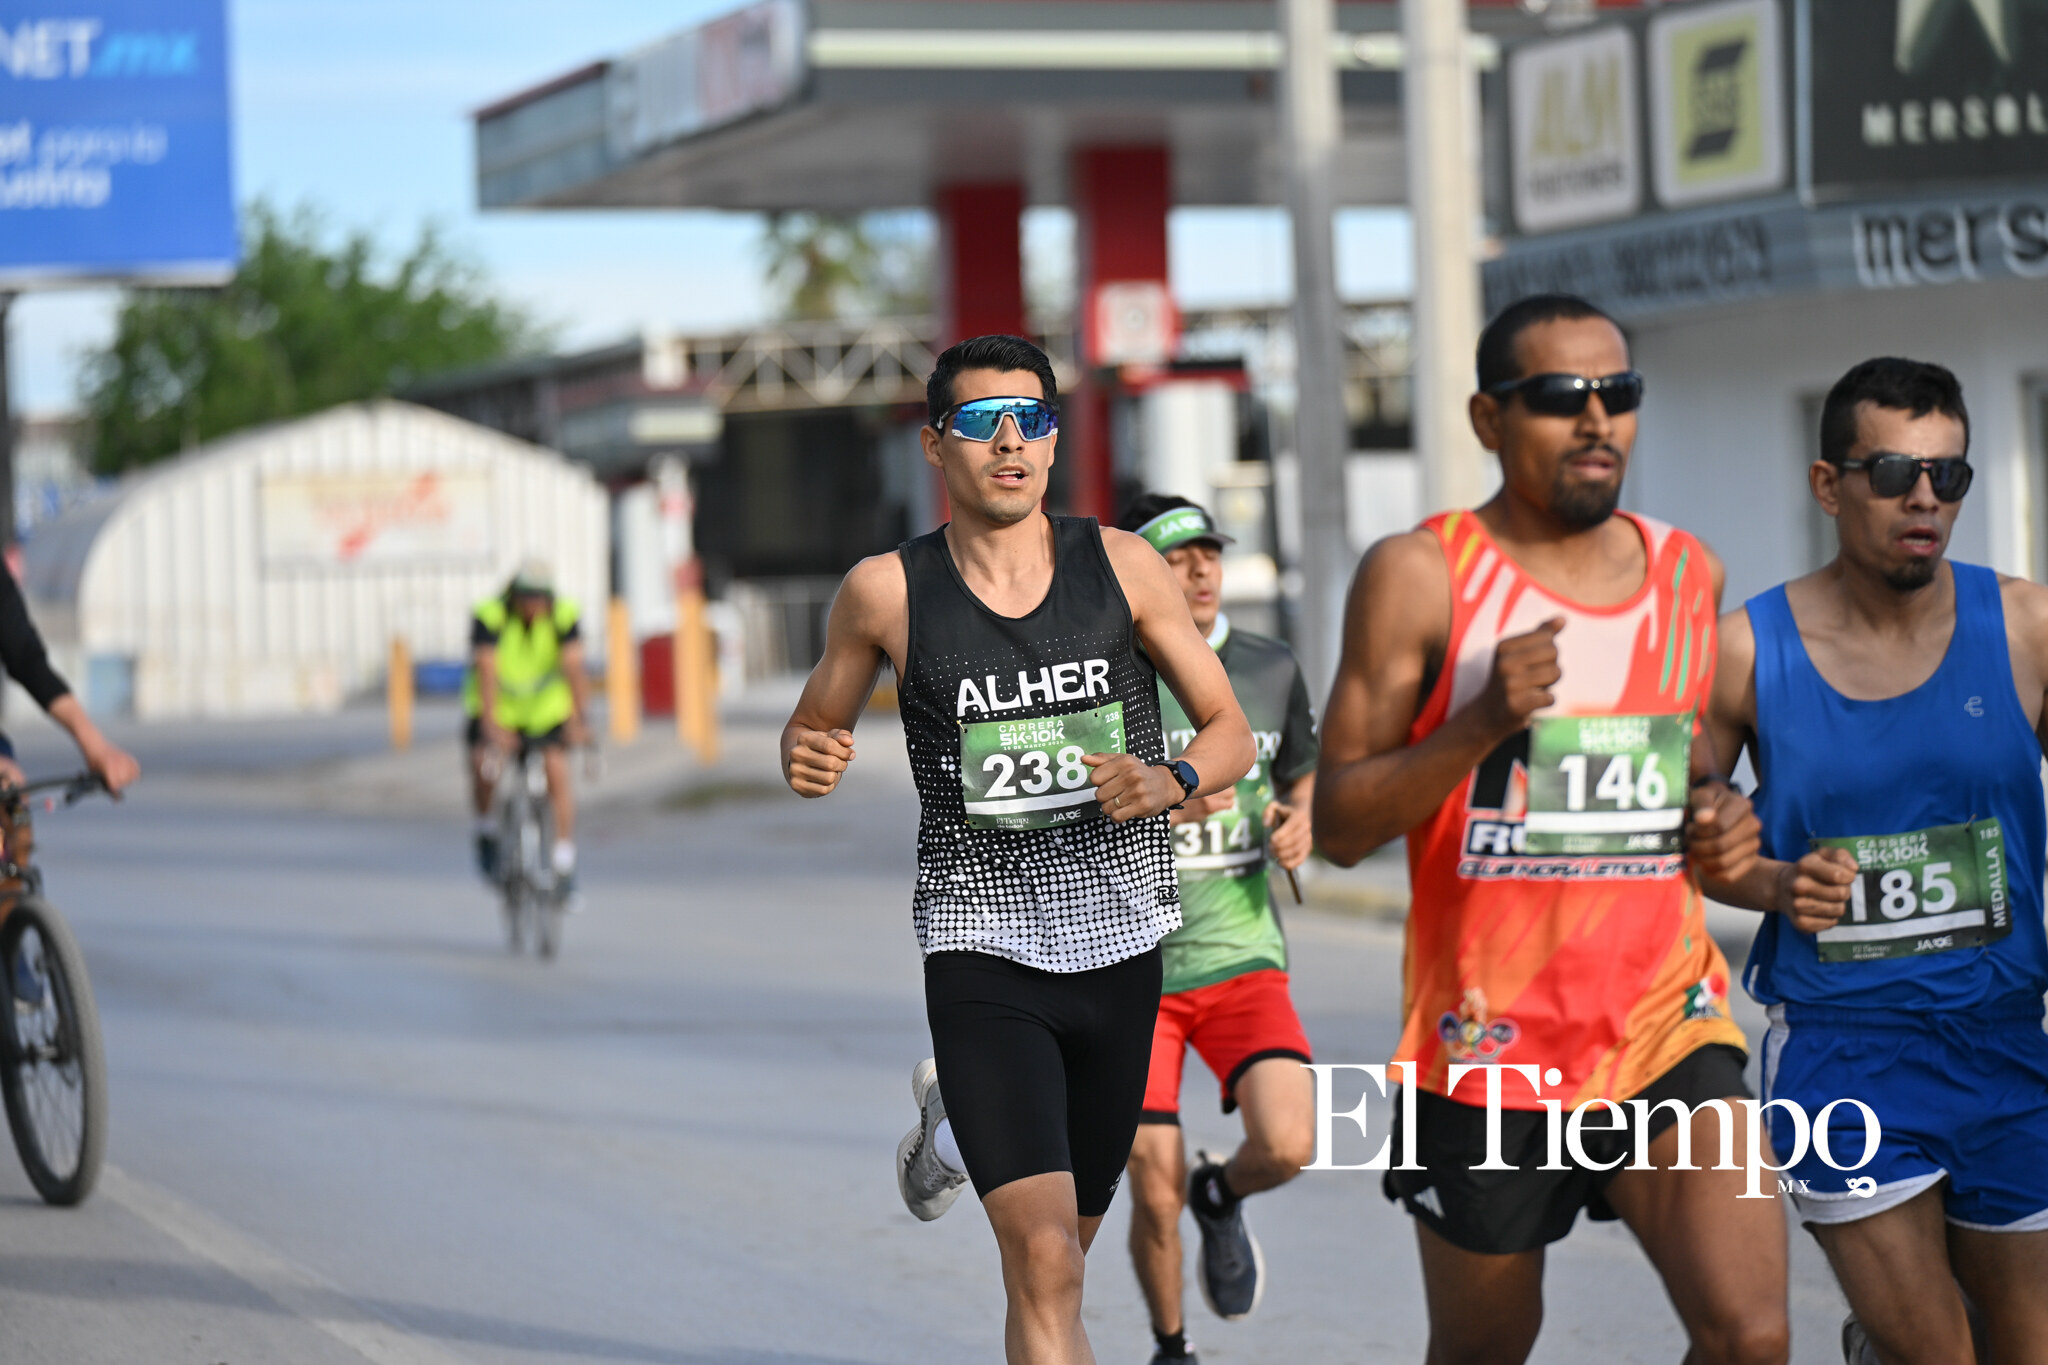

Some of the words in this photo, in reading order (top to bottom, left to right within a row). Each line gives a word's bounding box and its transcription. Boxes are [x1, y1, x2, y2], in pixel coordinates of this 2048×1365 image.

[957, 658, 1110, 717] ALHER
[999, 719, 1065, 733] CARRERA
[1105, 711, 1120, 723] 238
[982, 745, 1088, 799] 238
[1558, 752, 1669, 811] 146
[1174, 817, 1250, 856] 314
[1855, 833, 1928, 850] CARRERA
[1980, 826, 2000, 840] 185
[1850, 861, 1958, 922] 185
[1986, 846, 2006, 928] MEDALLA
